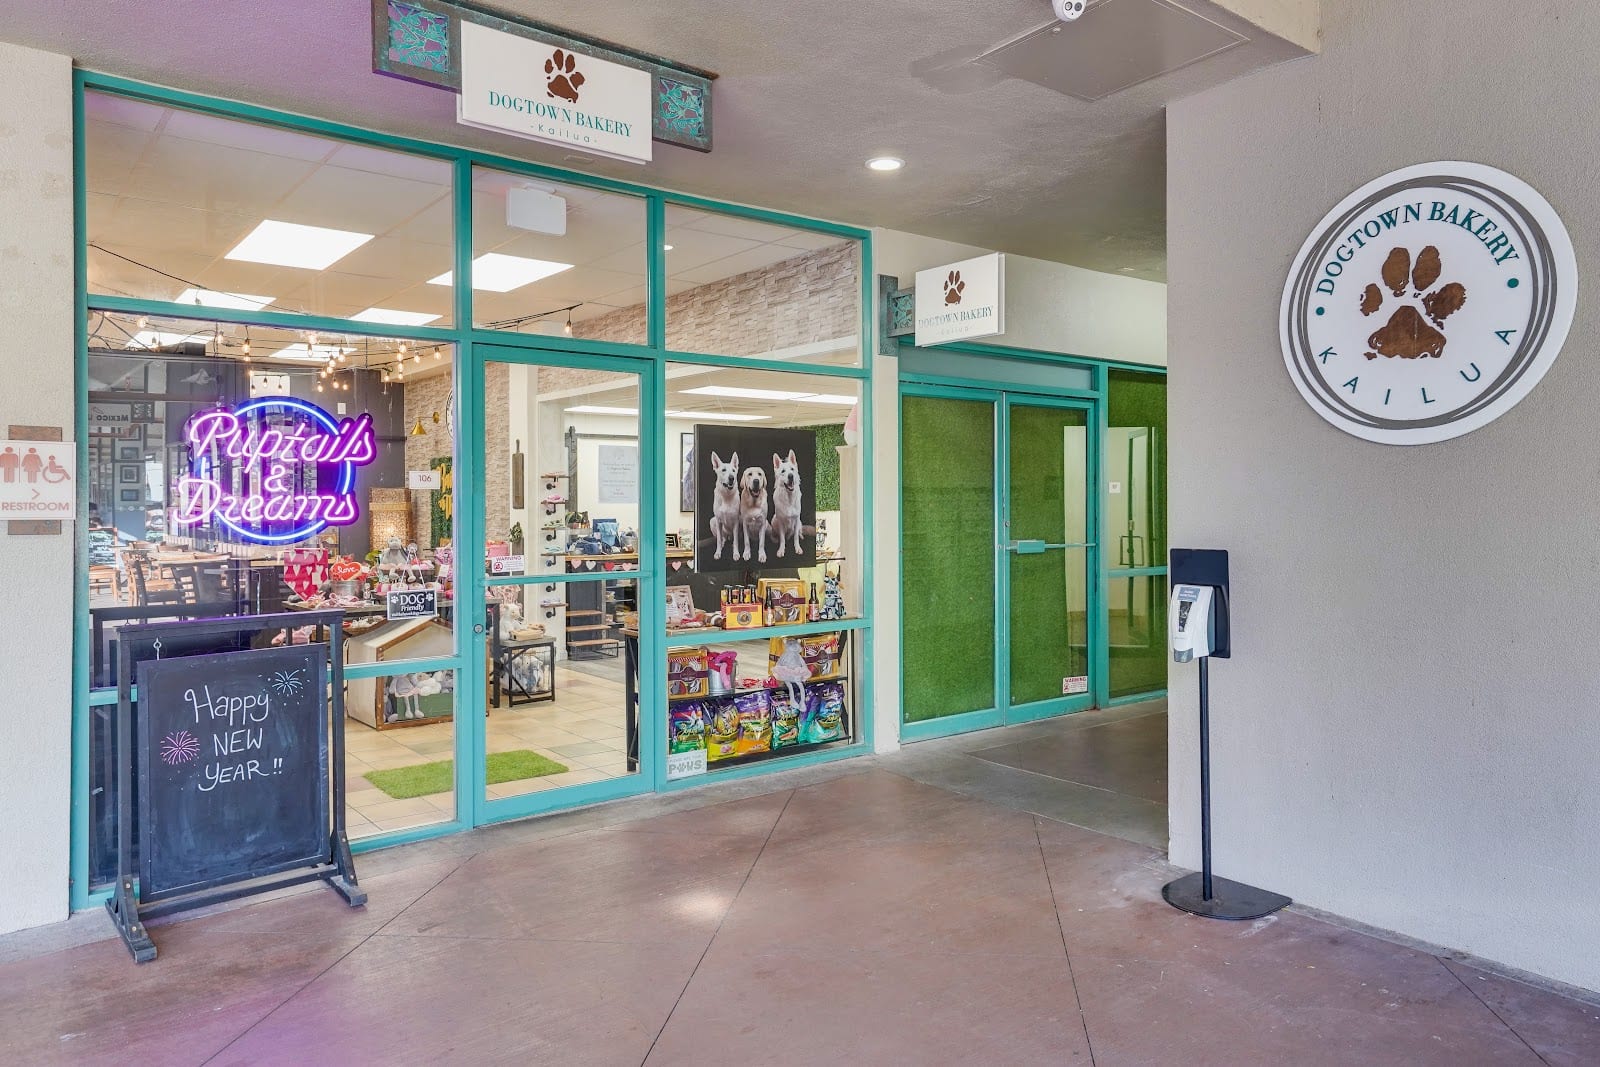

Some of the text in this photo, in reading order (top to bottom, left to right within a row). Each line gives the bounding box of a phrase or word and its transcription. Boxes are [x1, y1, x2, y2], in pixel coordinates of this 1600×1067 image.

[488, 90, 633, 137] DOGTOWN BAKERY
[1316, 201, 1519, 296] DOGTOWN BAKERY
[918, 305, 993, 329] DOGTOWN BAKERY
[1319, 327, 1517, 405] KAILUA
[189, 412, 374, 474] Puptails
[263, 464, 288, 493] &
[418, 474, 432, 482] 106
[1, 502, 70, 511] RESTROOM
[172, 477, 356, 524] Dreams
[337, 565, 357, 575] love
[400, 593, 425, 605] DOG
[400, 604, 425, 612] Friendly
[184, 685, 270, 726] Happy
[213, 727, 264, 756] NEW
